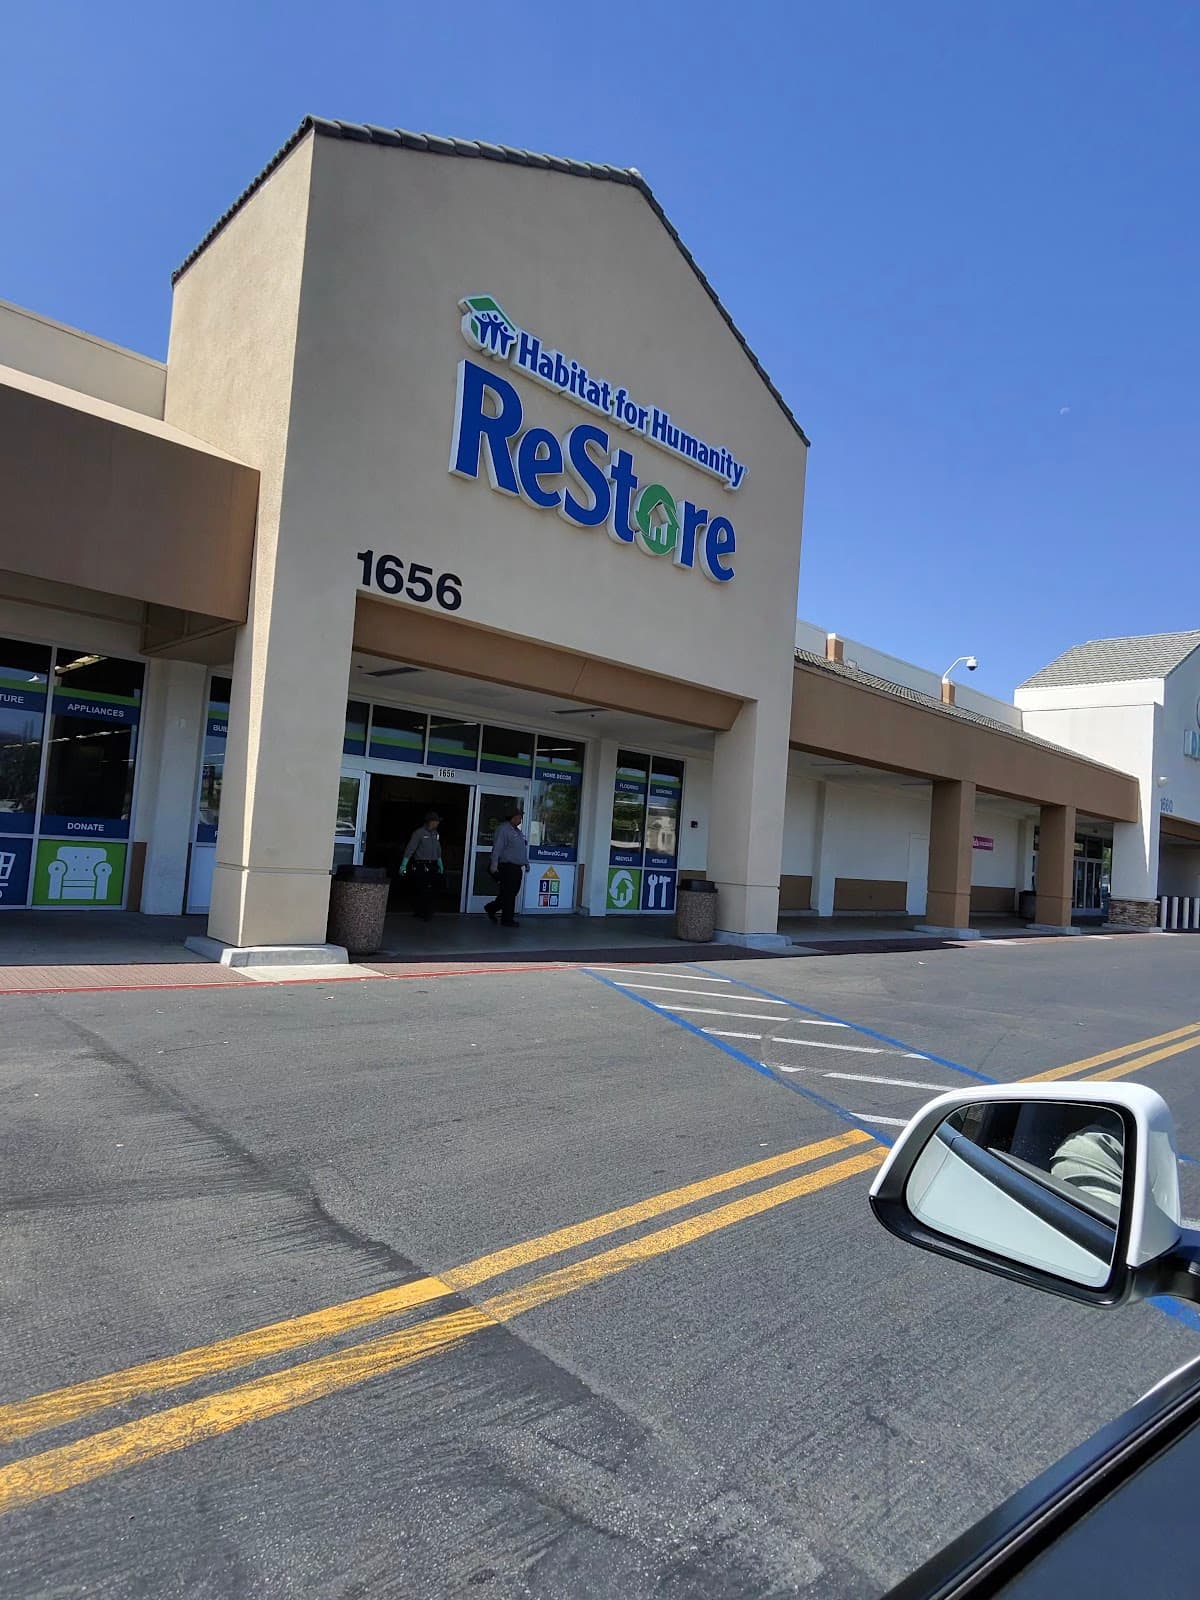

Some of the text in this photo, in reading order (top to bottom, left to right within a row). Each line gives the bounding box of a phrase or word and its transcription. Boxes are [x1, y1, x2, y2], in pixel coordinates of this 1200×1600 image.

[518, 331, 745, 488] Habitat for Humanity
[453, 359, 737, 582] ReStore
[357, 549, 463, 611] 1656
[67, 703, 125, 718] APPLIANCES
[439, 767, 455, 778] 1656
[67, 822, 105, 832] DONATE
